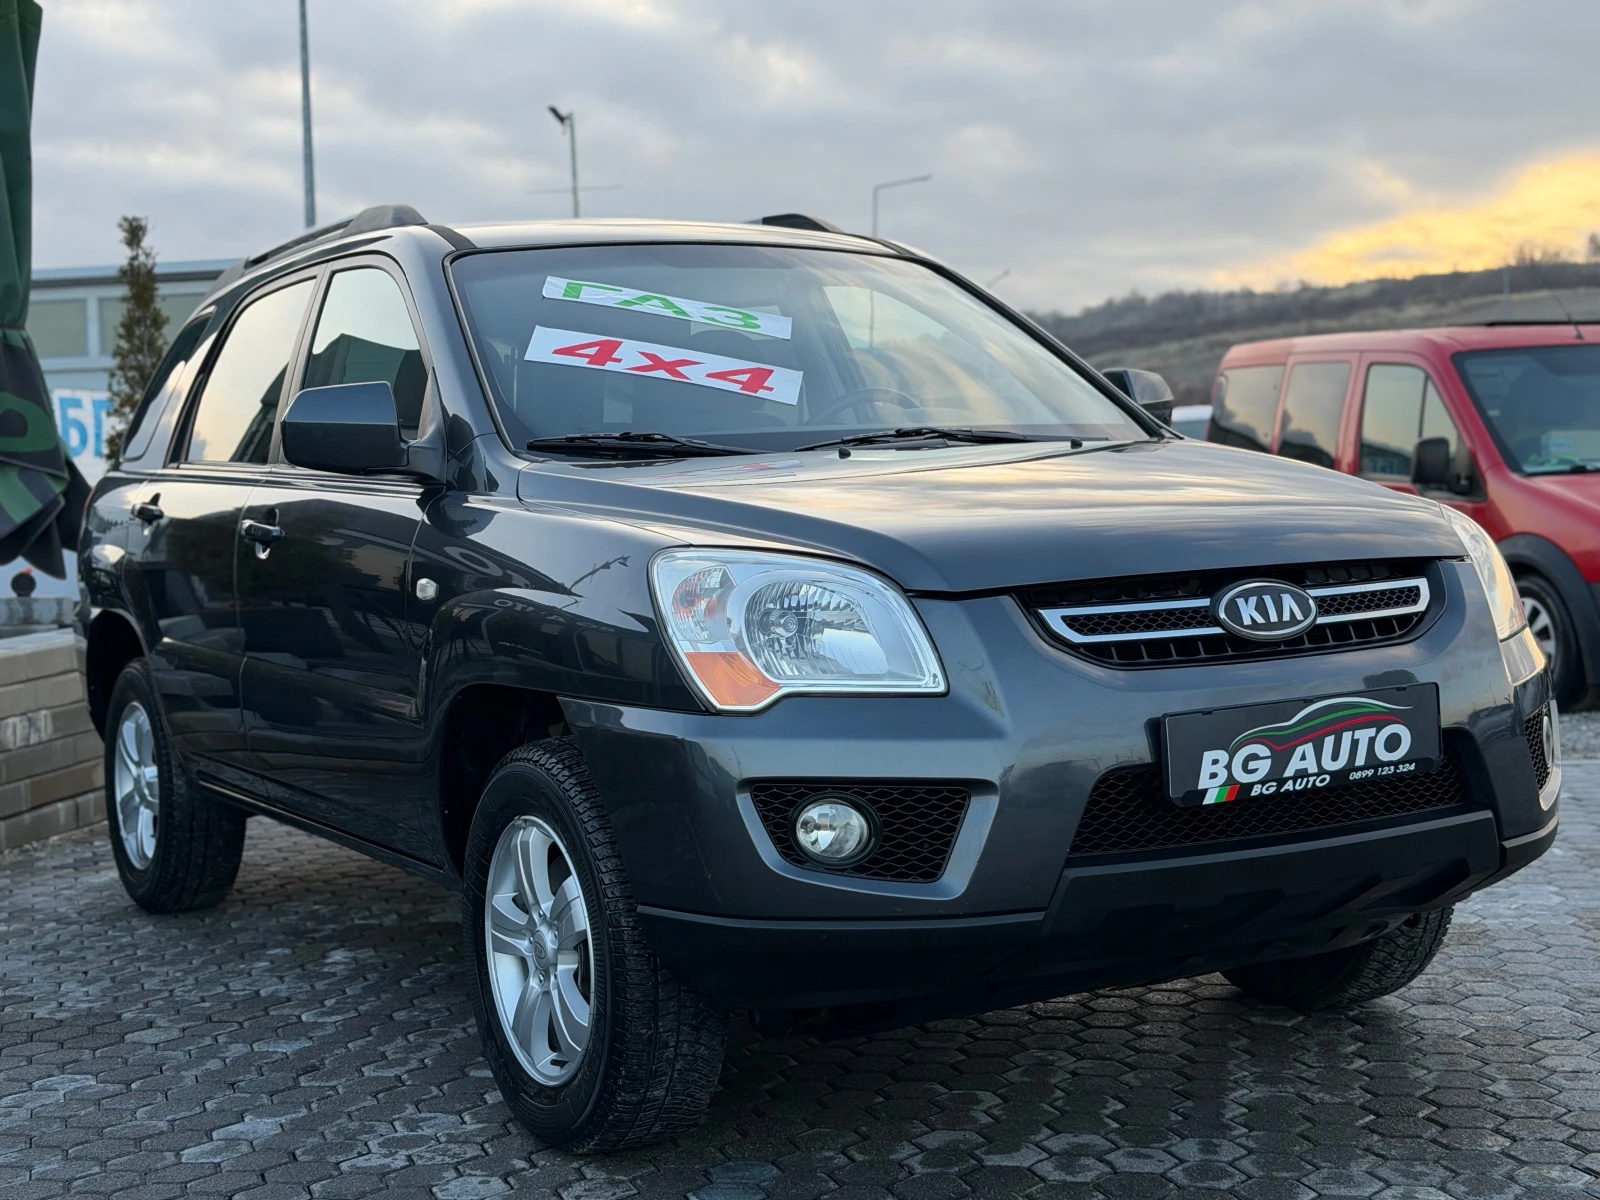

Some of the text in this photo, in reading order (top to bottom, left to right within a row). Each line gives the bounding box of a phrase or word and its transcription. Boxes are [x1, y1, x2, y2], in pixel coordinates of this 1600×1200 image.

[1235, 593, 1305, 625] KIA
[1197, 723, 1412, 790] BG AUTO
[1348, 762, 1416, 781] 0899 123 324
[1250, 774, 1331, 797] BG AUTO
